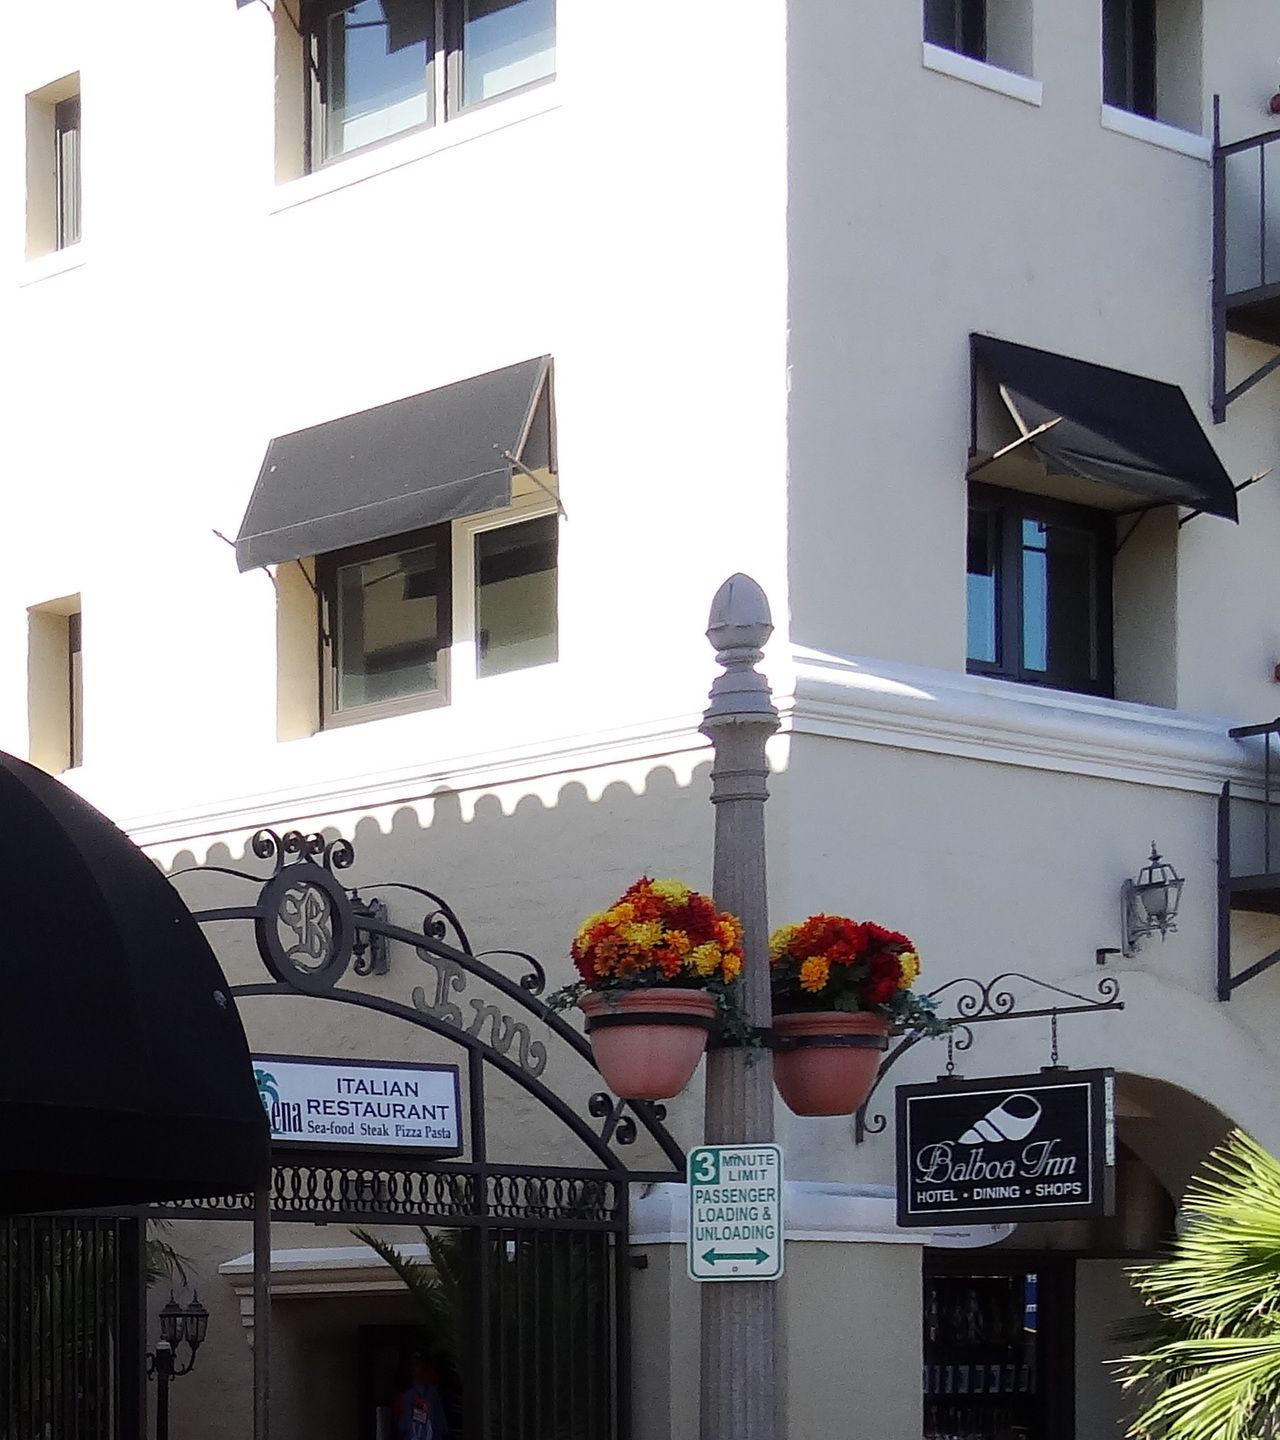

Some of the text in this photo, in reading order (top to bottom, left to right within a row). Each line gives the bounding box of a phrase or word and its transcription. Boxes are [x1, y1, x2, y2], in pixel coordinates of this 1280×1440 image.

[412, 946, 547, 1077] Inn
[336, 1078, 419, 1098] ITALIAN
[270, 1101, 303, 1133] ena
[306, 1099, 450, 1121] RESTAURANT
[307, 1120, 452, 1139] Sea-food Steak Pizza Pasta
[694, 1151, 717, 1182] 3
[722, 1154, 775, 1167] MINUTE
[915, 1138, 1078, 1184] Balboa Inn
[728, 1169, 768, 1181] LIMIT
[695, 1188, 776, 1204] PASSENGER
[917, 1182, 1082, 1203] HOTEL DINING SHOPS
[698, 1206, 771, 1222] LOADING &
[695, 1226, 775, 1241] UNLOADING
